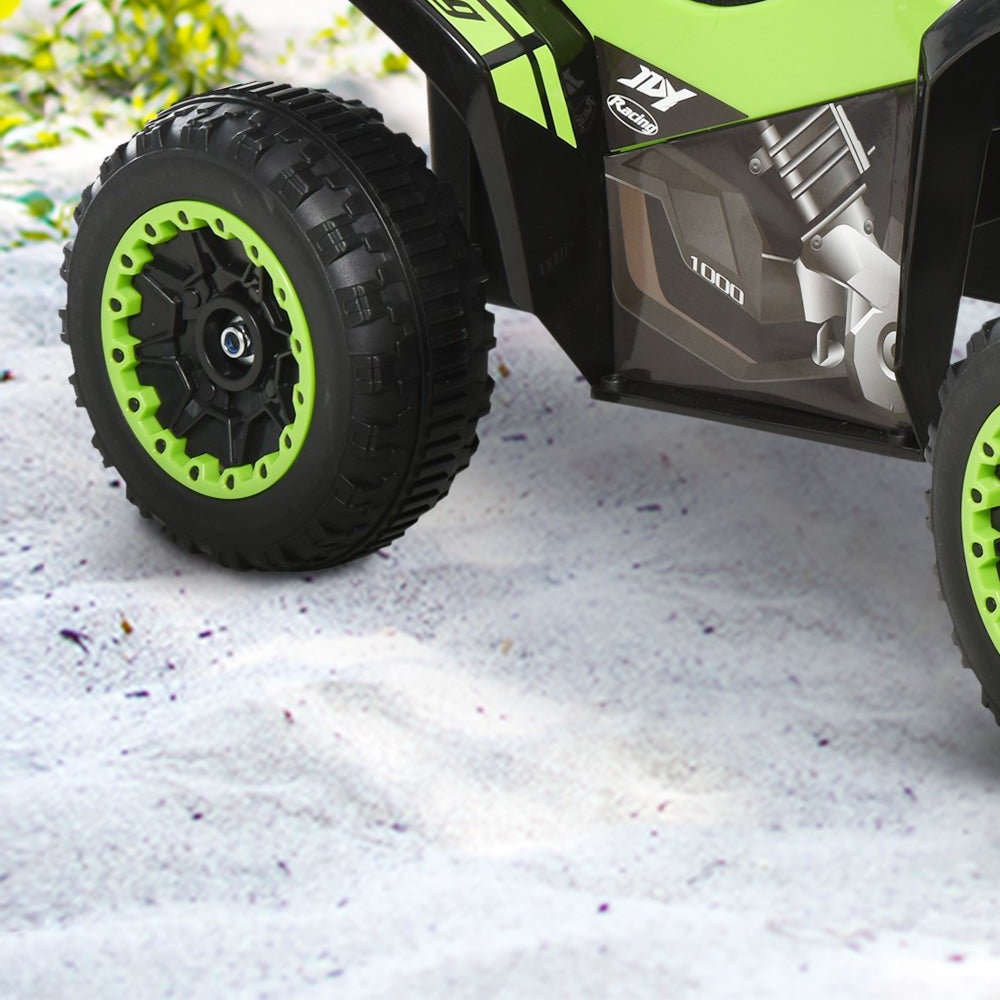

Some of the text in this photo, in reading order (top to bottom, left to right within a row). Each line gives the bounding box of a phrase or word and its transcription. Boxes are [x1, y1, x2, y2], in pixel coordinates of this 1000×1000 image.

[616, 64, 697, 112] JDY
[607, 96, 657, 134] Racing
[690, 255, 745, 305] 1000
